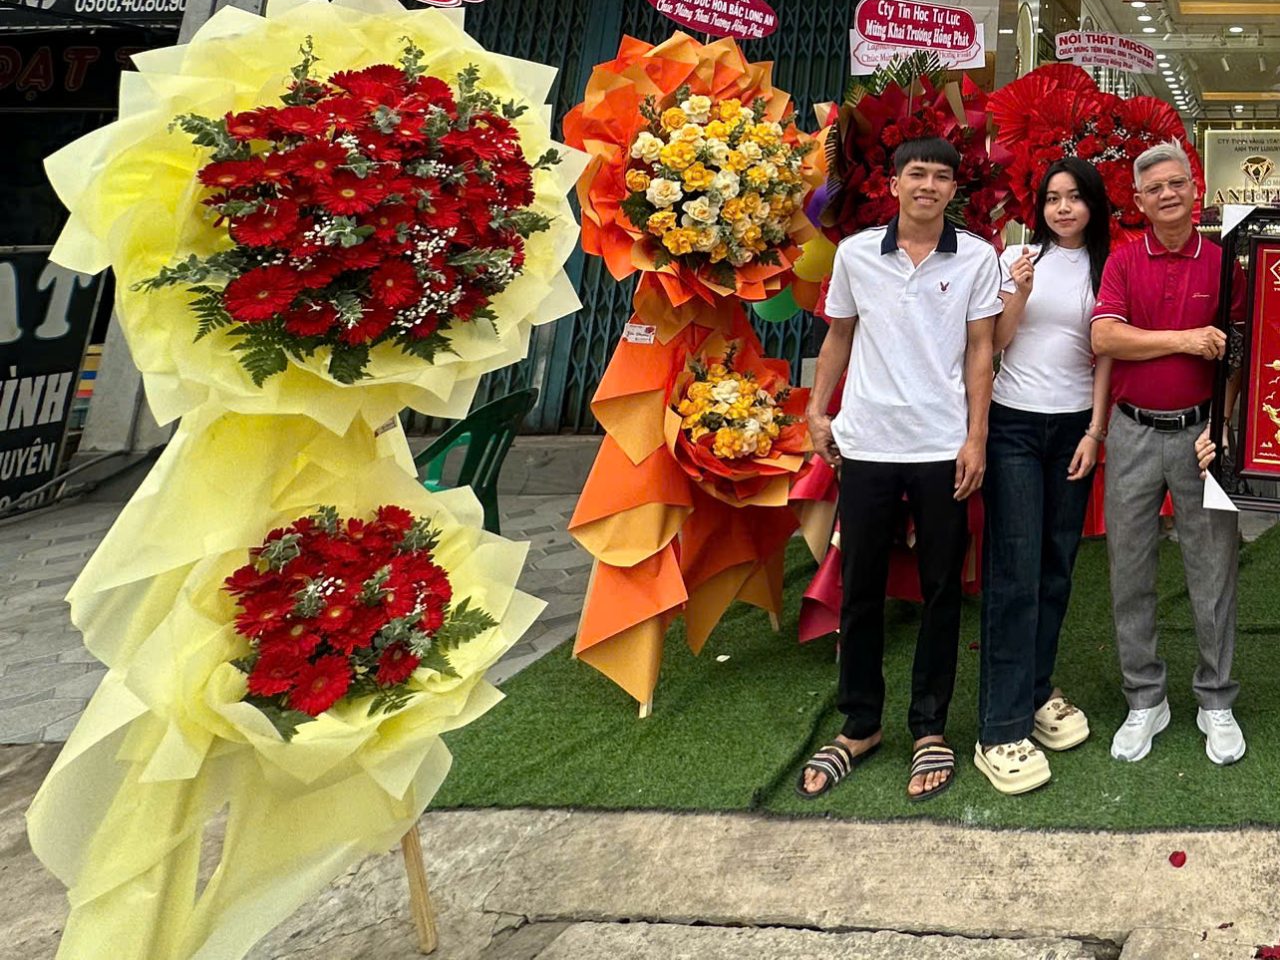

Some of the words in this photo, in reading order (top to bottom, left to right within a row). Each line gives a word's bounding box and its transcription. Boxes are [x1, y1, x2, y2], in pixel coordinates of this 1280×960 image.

[744, 7, 764, 23] LONG
[763, 14, 775, 27] AN
[878, 0, 895, 19] Cty
[898, 3, 911, 19] Tin
[913, 5, 929, 25] Học
[888, 22, 905, 40] Khai
